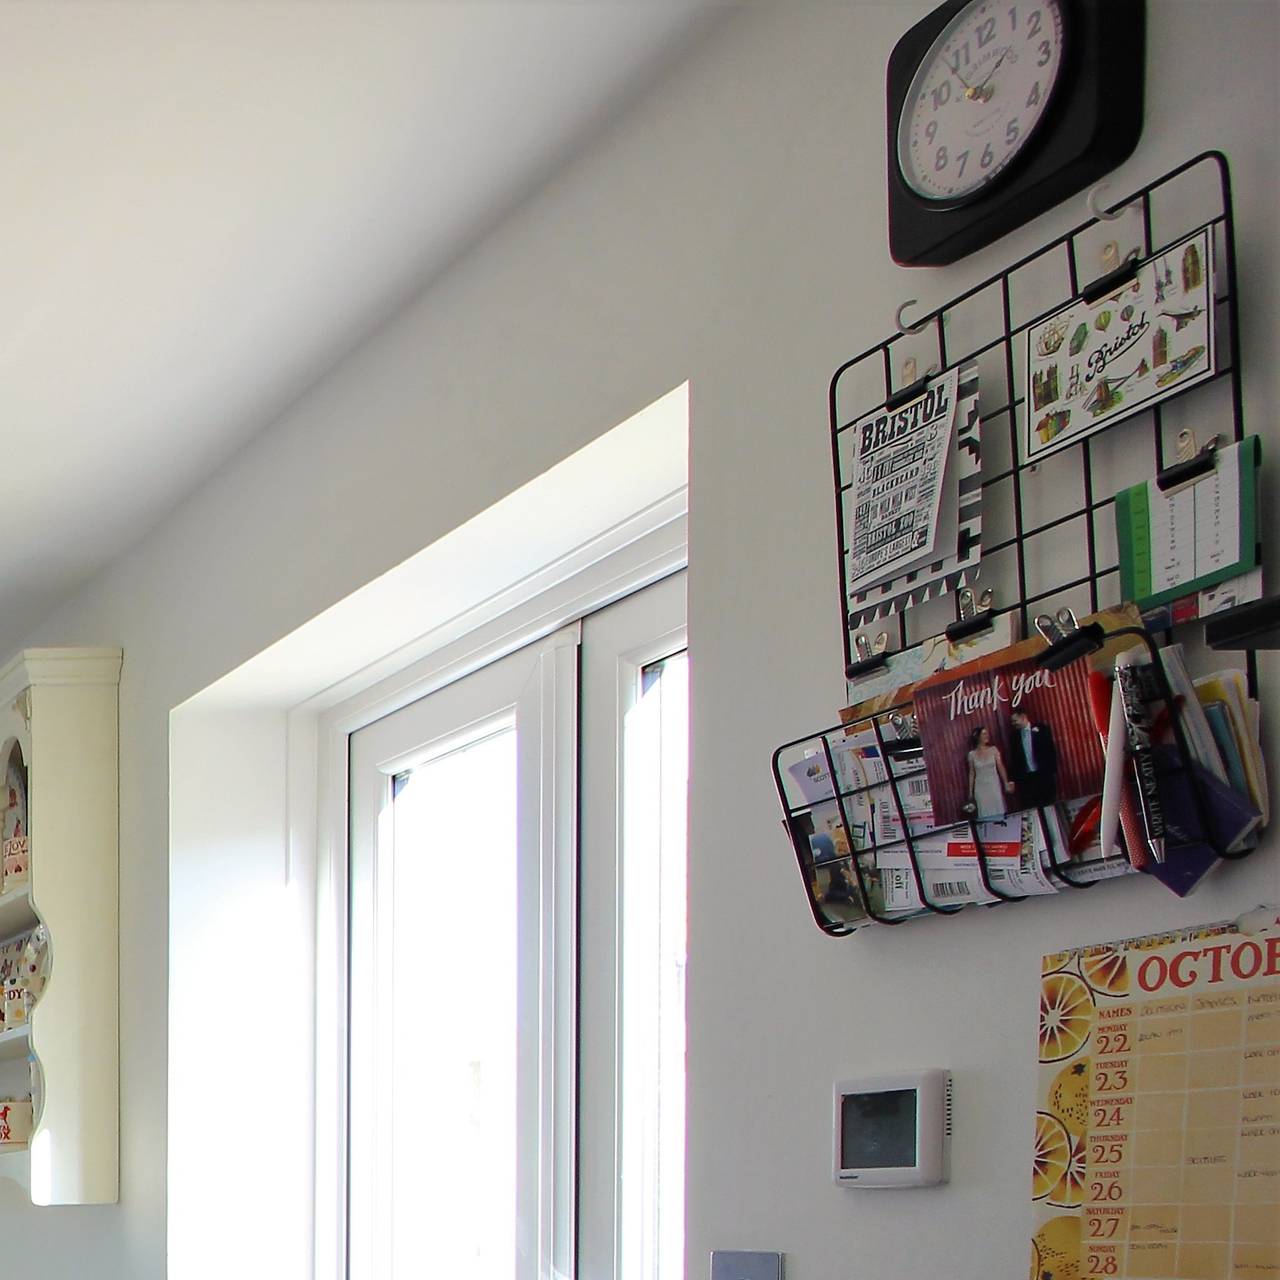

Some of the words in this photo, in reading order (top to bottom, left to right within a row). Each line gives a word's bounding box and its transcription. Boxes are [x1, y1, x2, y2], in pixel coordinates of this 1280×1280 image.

[1008, 6, 1017, 31] 1
[1026, 10, 1042, 40] 2
[975, 17, 997, 49] 12
[1037, 40, 1051, 67] 3
[931, 79, 951, 111] 10
[1025, 81, 1040, 108] 4
[925, 120, 938, 146] 9
[1005, 117, 1020, 145] 5
[935, 146, 948, 171] 8
[956, 151, 968, 179] 7
[980, 142, 994, 169] 6
[1085, 311, 1150, 382] Bristol
[860, 384, 948, 459] BRISTOL
[942, 676, 1008, 721] Thank
[1011, 669, 1057, 707] you
[1098, 1007, 1133, 1020] NAMES
[1097, 1024, 1129, 1034] MONDAY
[1096, 1033, 1131, 1055] 22
[1095, 1060, 1129, 1070] TUESDAY
[1095, 1071, 1128, 1091] 23
[1090, 1096, 1135, 1107] WEDNESDAY
[1094, 1107, 1124, 1128] 24
[1090, 1134, 1128, 1142] THURSDAY
[1092, 1144, 1123, 1164] 25
[1095, 1171, 1121, 1179] FRIDAY
[1091, 1181, 1123, 1201] 26
[1085, 1207, 1125, 1216] SATURDAY
[1089, 1218, 1120, 1238] 27
[1088, 1245, 1116, 1253] SUNDAY
[1087, 1255, 1119, 1275] 28
